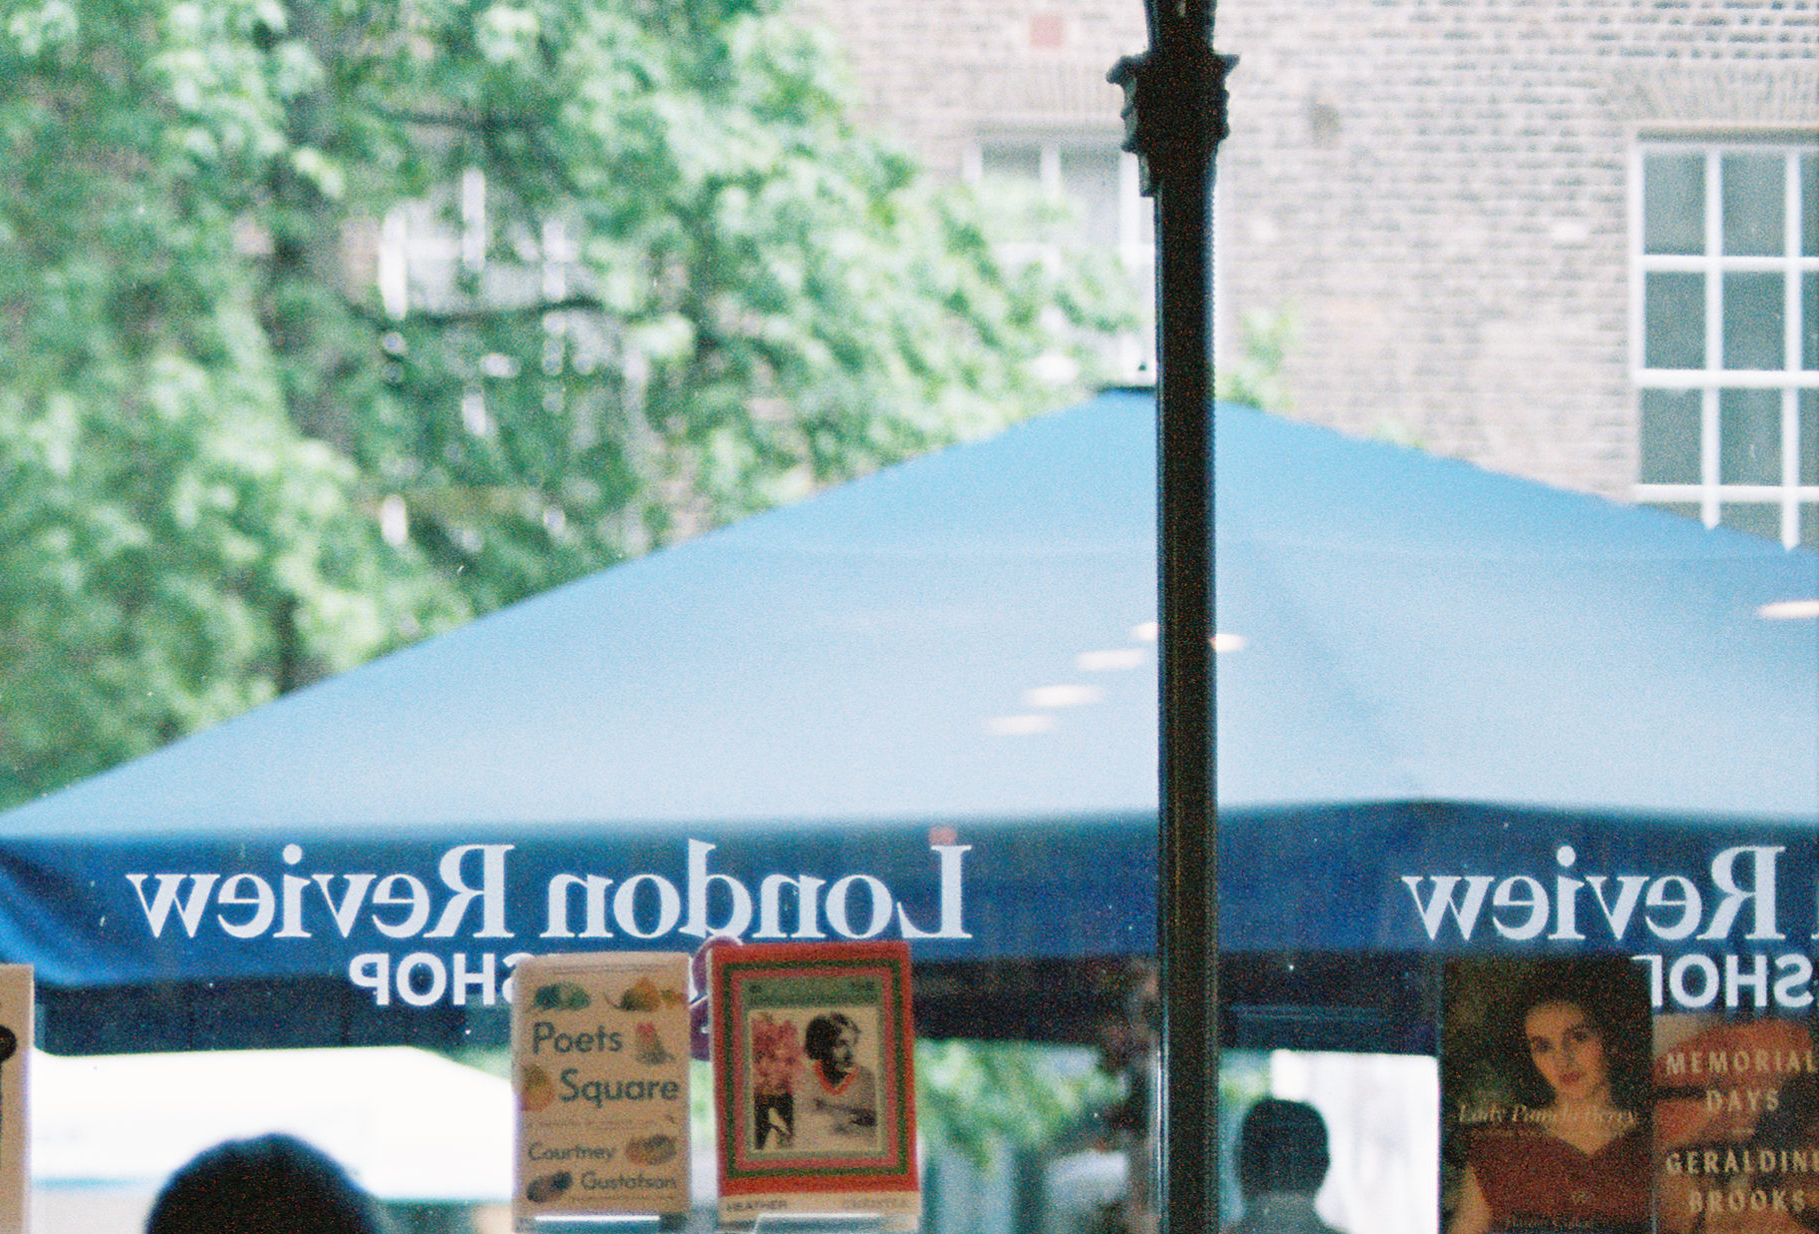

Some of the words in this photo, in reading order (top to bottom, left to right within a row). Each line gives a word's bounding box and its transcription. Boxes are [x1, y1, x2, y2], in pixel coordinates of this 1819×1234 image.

[532, 1021, 624, 1055] Poets
[1665, 1049, 1818, 1076] MEMORIAL
[559, 1068, 680, 1108] Square
[1706, 1089, 1780, 1113] DAYS
[527, 1142, 616, 1163] Courtney
[1689, 1188, 1807, 1213] BROOKS
